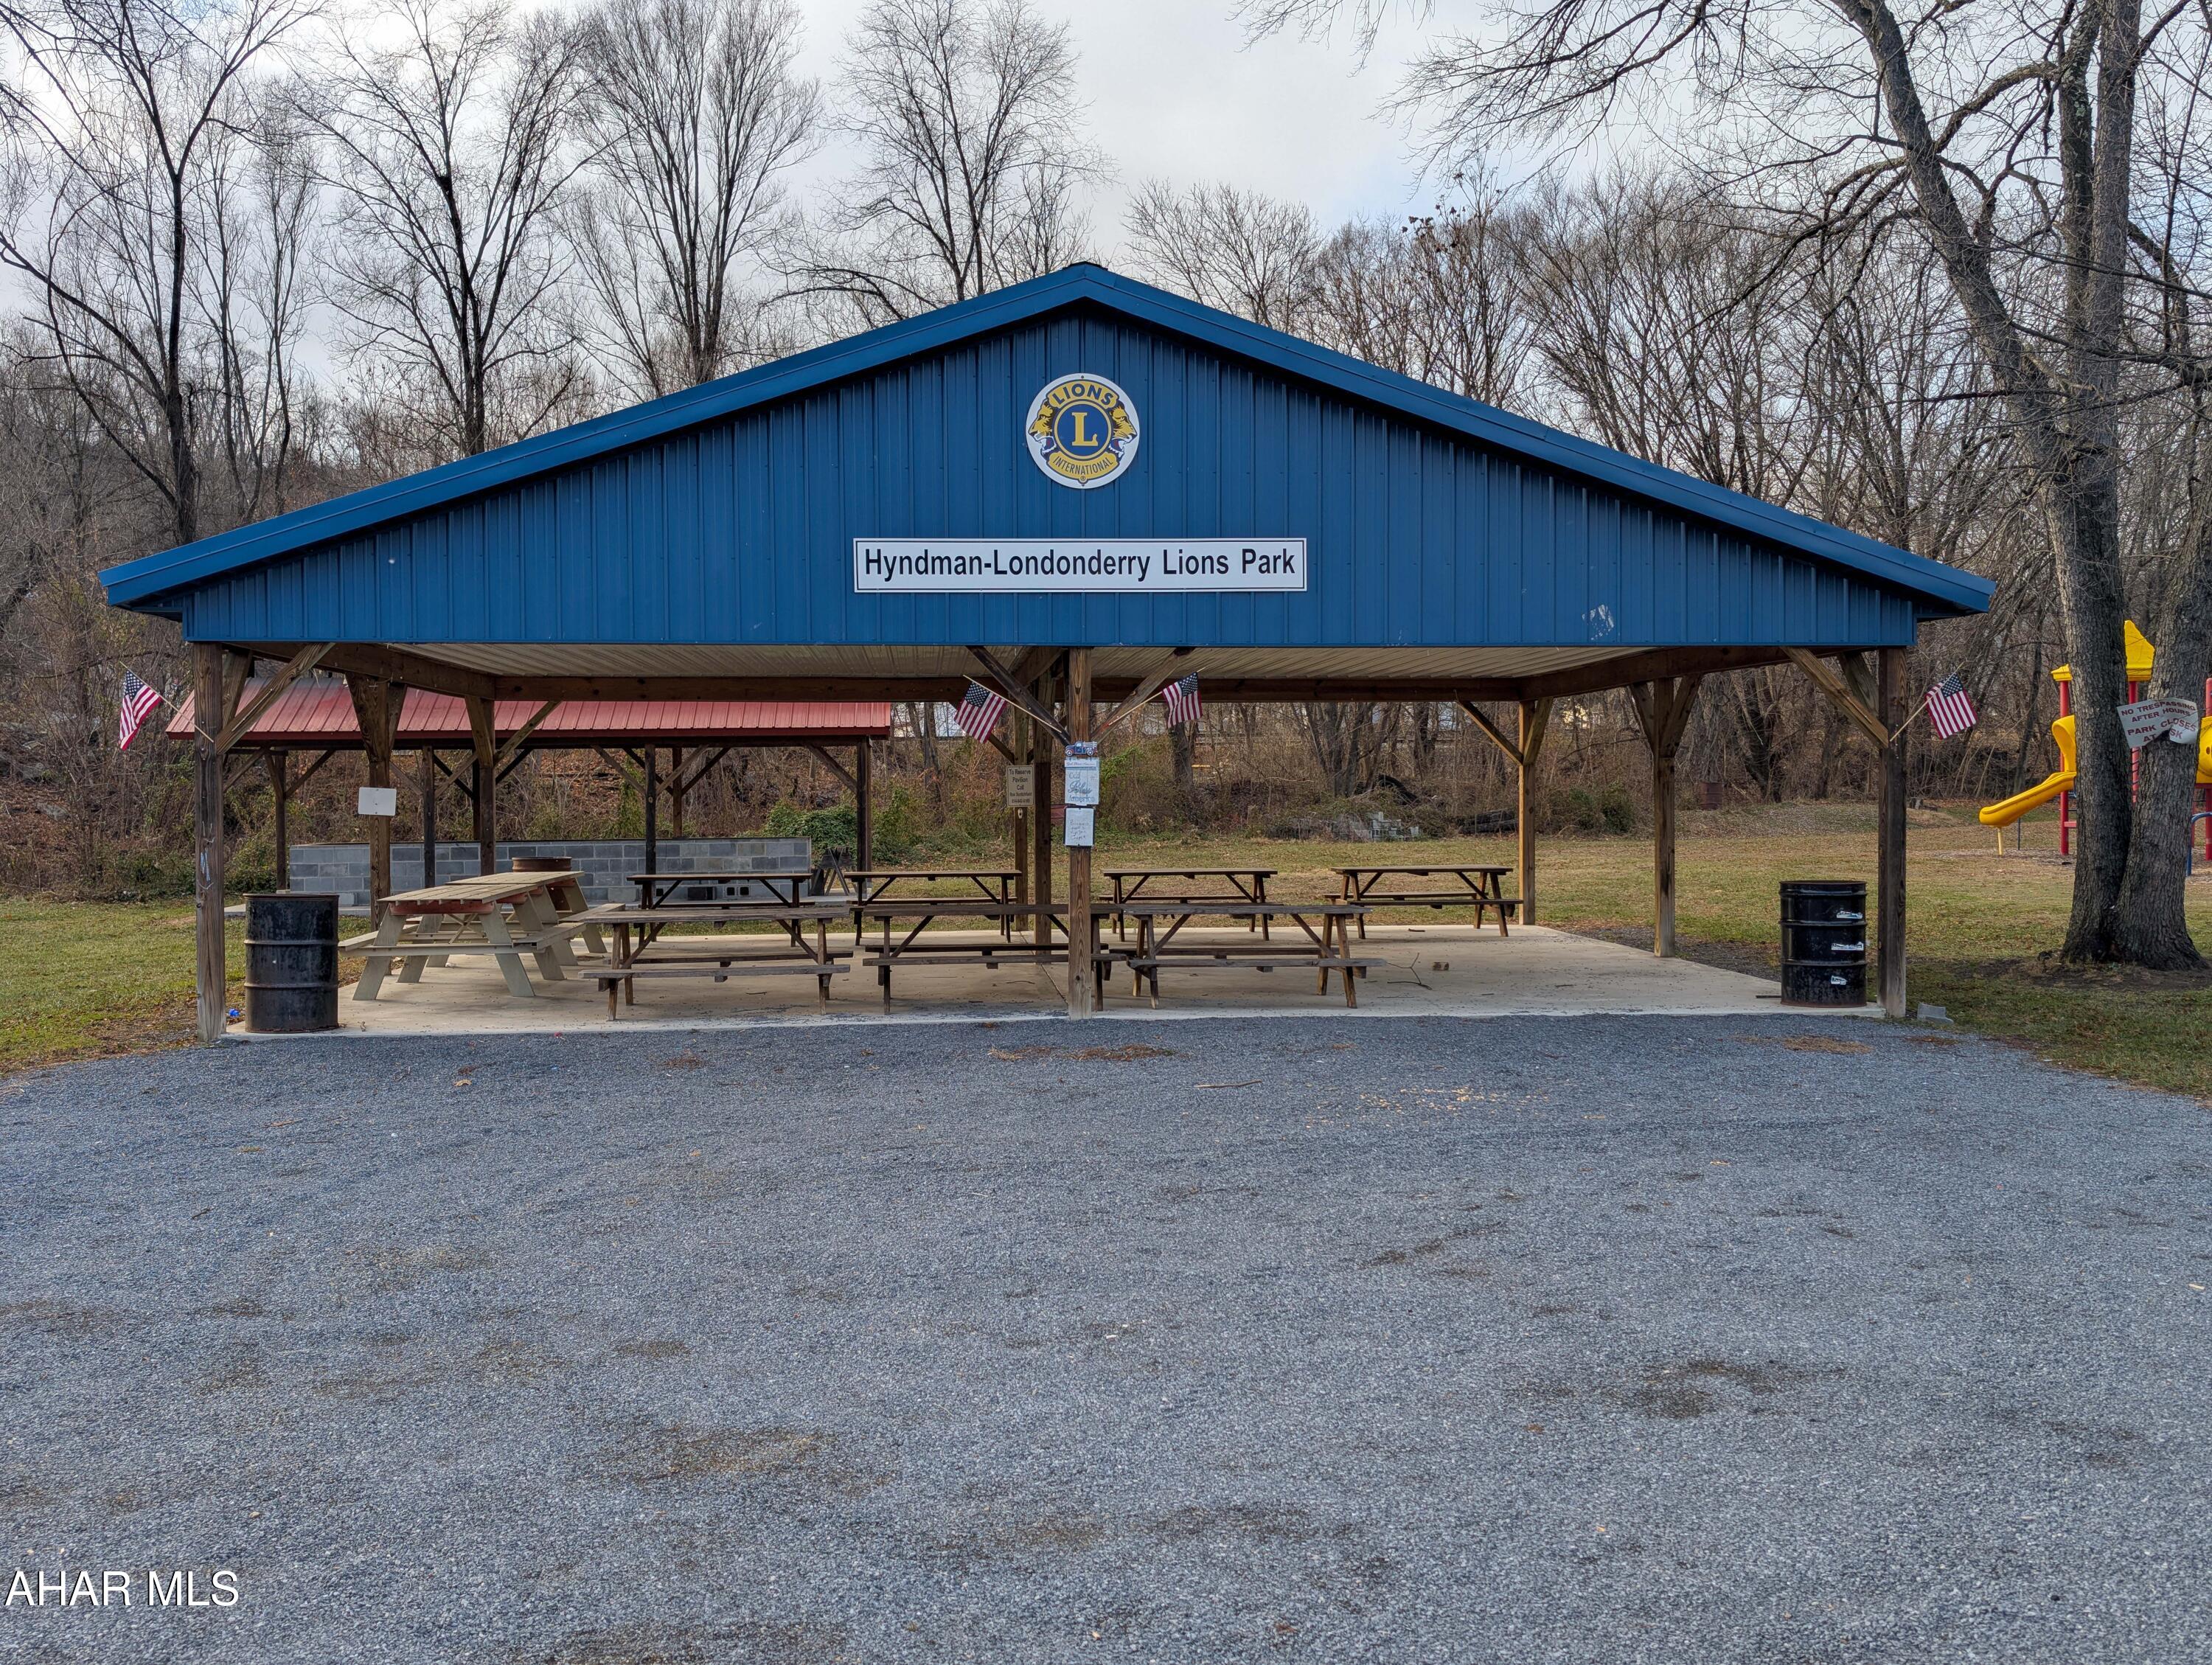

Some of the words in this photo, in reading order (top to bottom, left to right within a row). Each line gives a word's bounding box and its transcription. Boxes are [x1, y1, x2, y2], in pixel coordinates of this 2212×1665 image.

[1052, 383, 1113, 406] LIONS
[1072, 412, 1099, 446] L
[1053, 456, 1113, 475] INTERNATIONAL
[865, 549, 1150, 582] Hyndman-Londonderry
[1163, 549, 1229, 575] Lions
[1242, 548, 1295, 574] Park
[2132, 712, 2160, 722] AFTER
[2163, 708, 2191, 716] HOURS
[2137, 701, 2196, 712] TRESPASSING
[2127, 725, 2156, 735] PARK
[2160, 718, 2197, 731] CLOSES
[2143, 734, 2157, 742] AT
